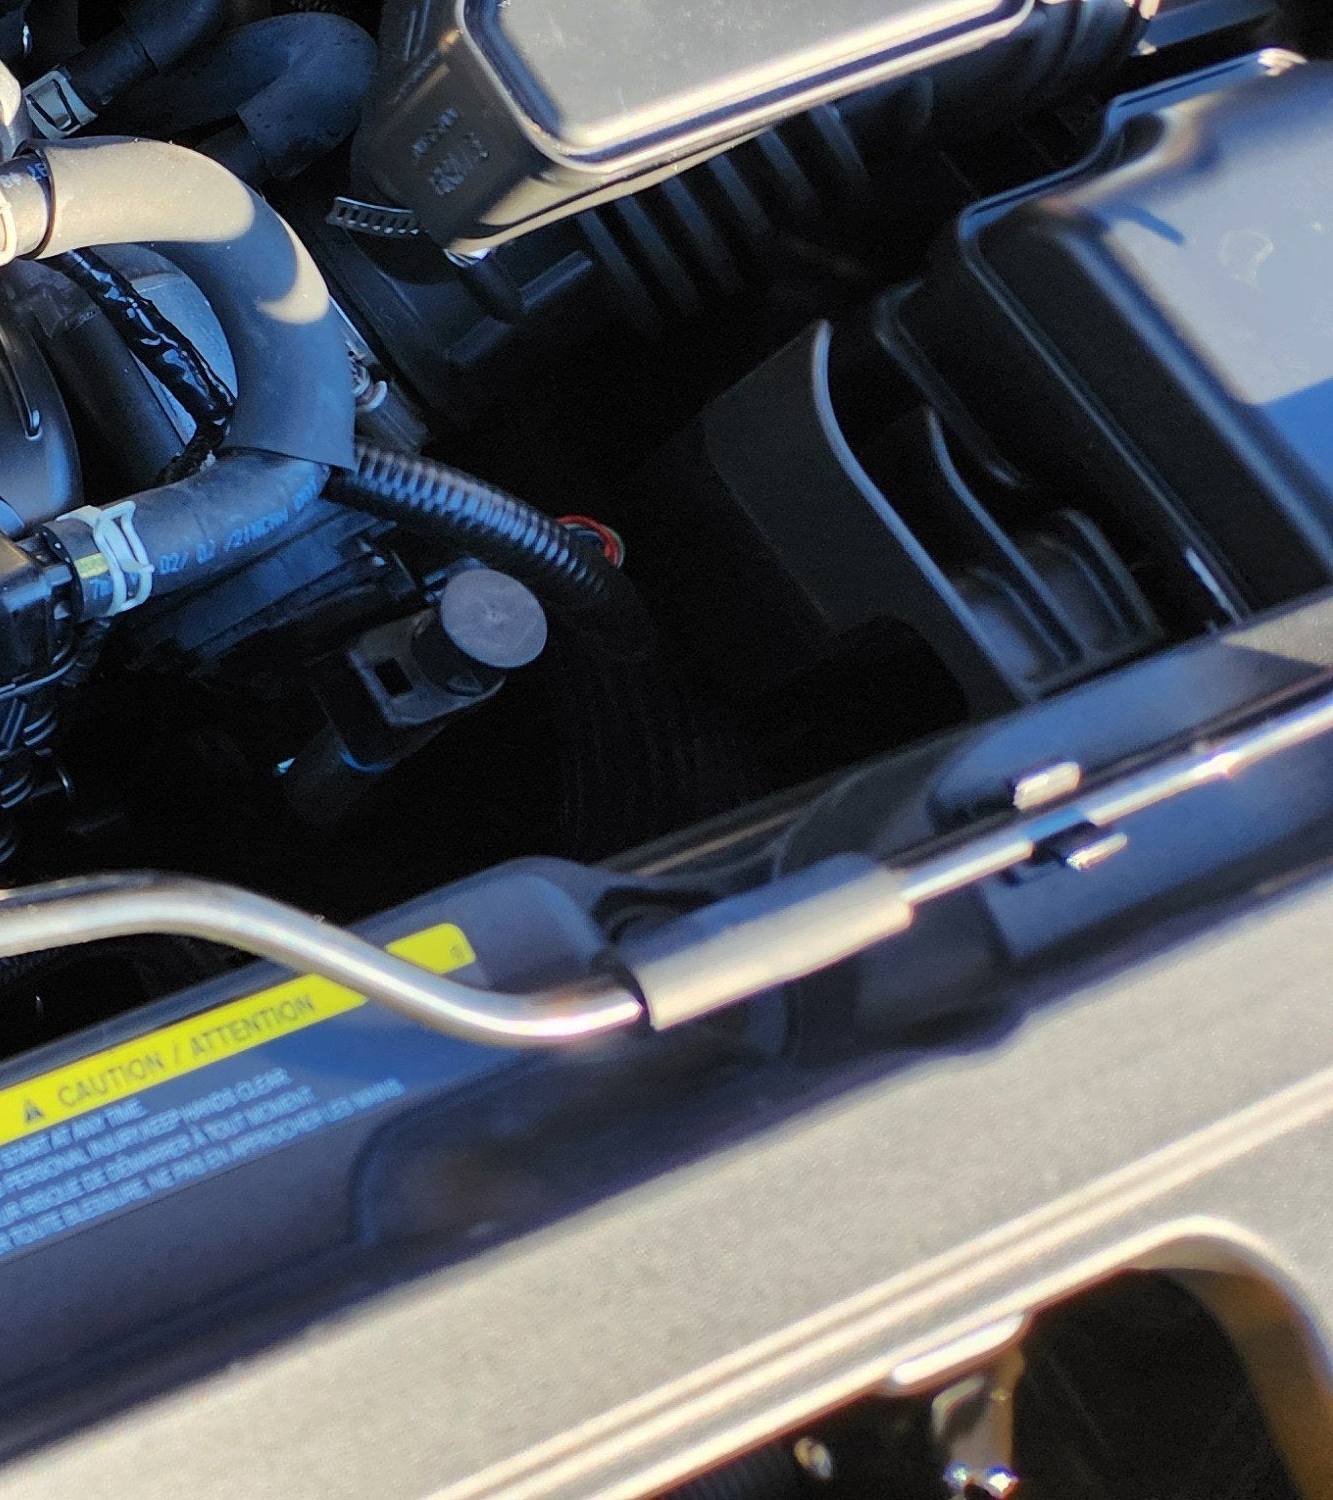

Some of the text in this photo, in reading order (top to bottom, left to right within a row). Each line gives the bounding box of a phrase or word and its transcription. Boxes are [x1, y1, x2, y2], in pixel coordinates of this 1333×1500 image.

[55, 1051, 166, 1109] CAUTION
[187, 993, 317, 1057] ATTENTION
[47, 1124, 74, 1150] AT
[69, 1111, 107, 1141] ANY
[103, 1096, 147, 1128] TIME
[138, 1108, 182, 1140] KEEP
[79, 1166, 108, 1192] DE
